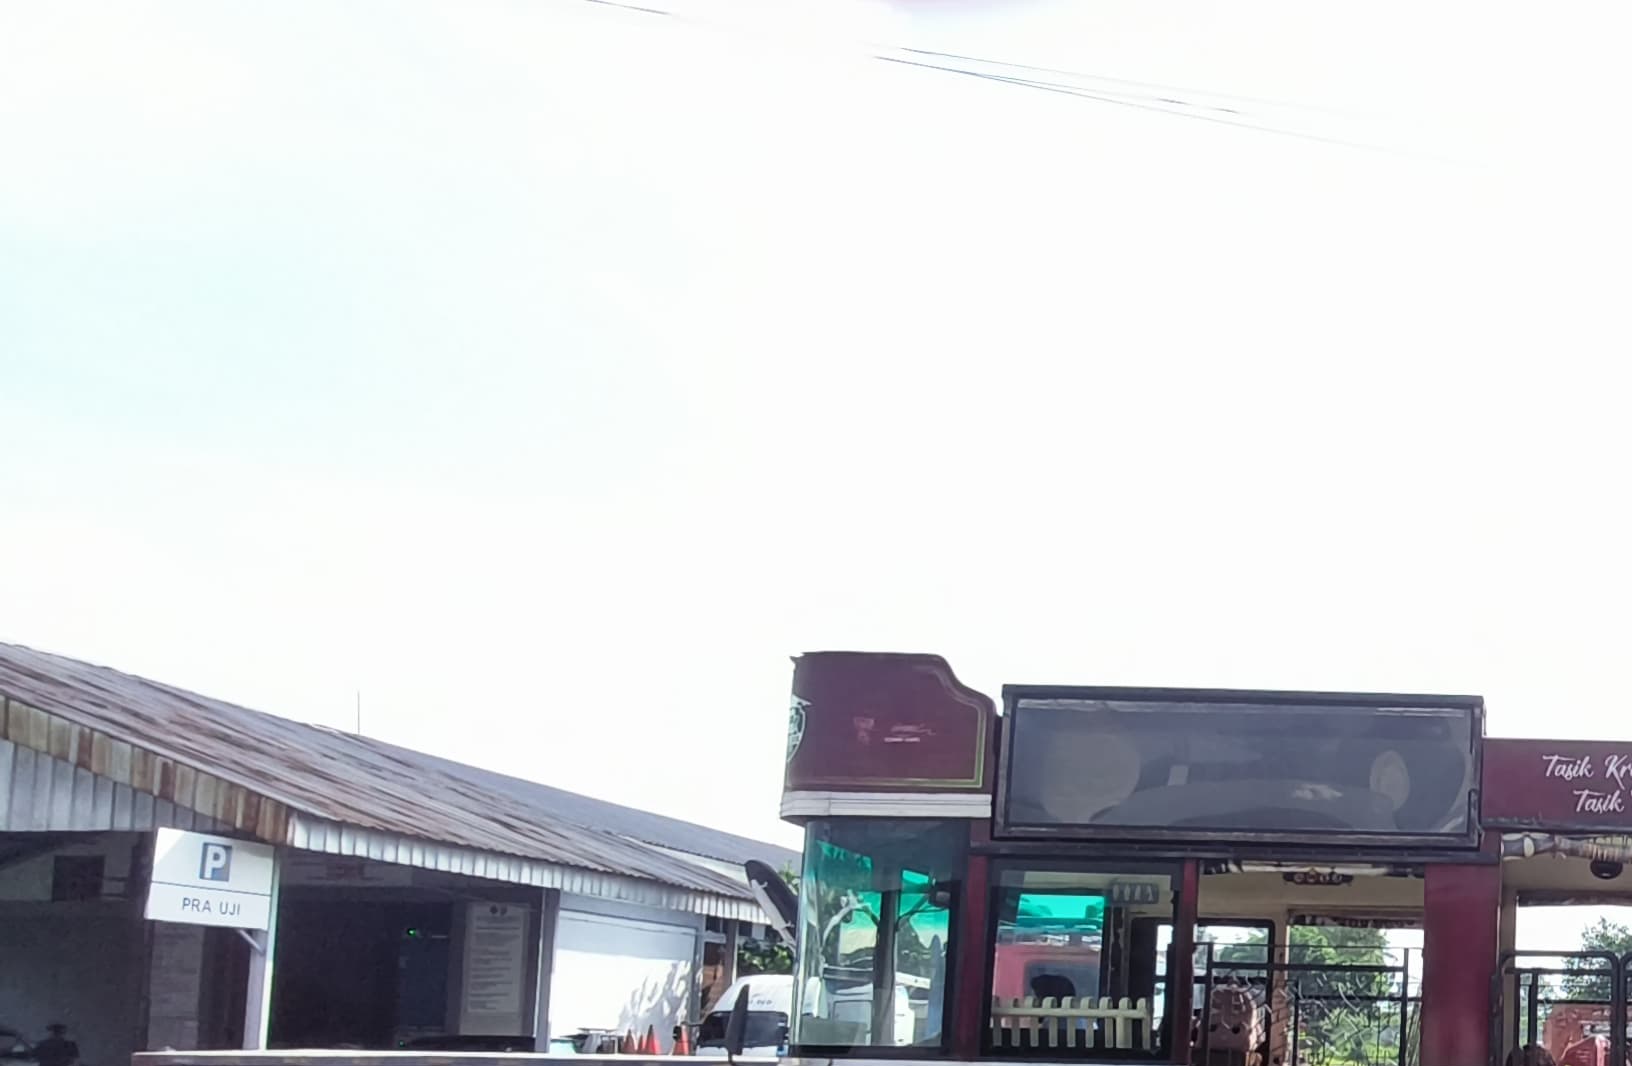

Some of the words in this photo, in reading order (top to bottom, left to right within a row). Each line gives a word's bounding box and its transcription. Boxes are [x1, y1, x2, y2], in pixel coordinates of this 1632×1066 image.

[1542, 755, 1593, 781] Tasik
[1573, 789, 1624, 813] Tasik
[203, 844, 226, 879] P
[182, 897, 211, 912] PRA
[219, 901, 241, 915] UJI
